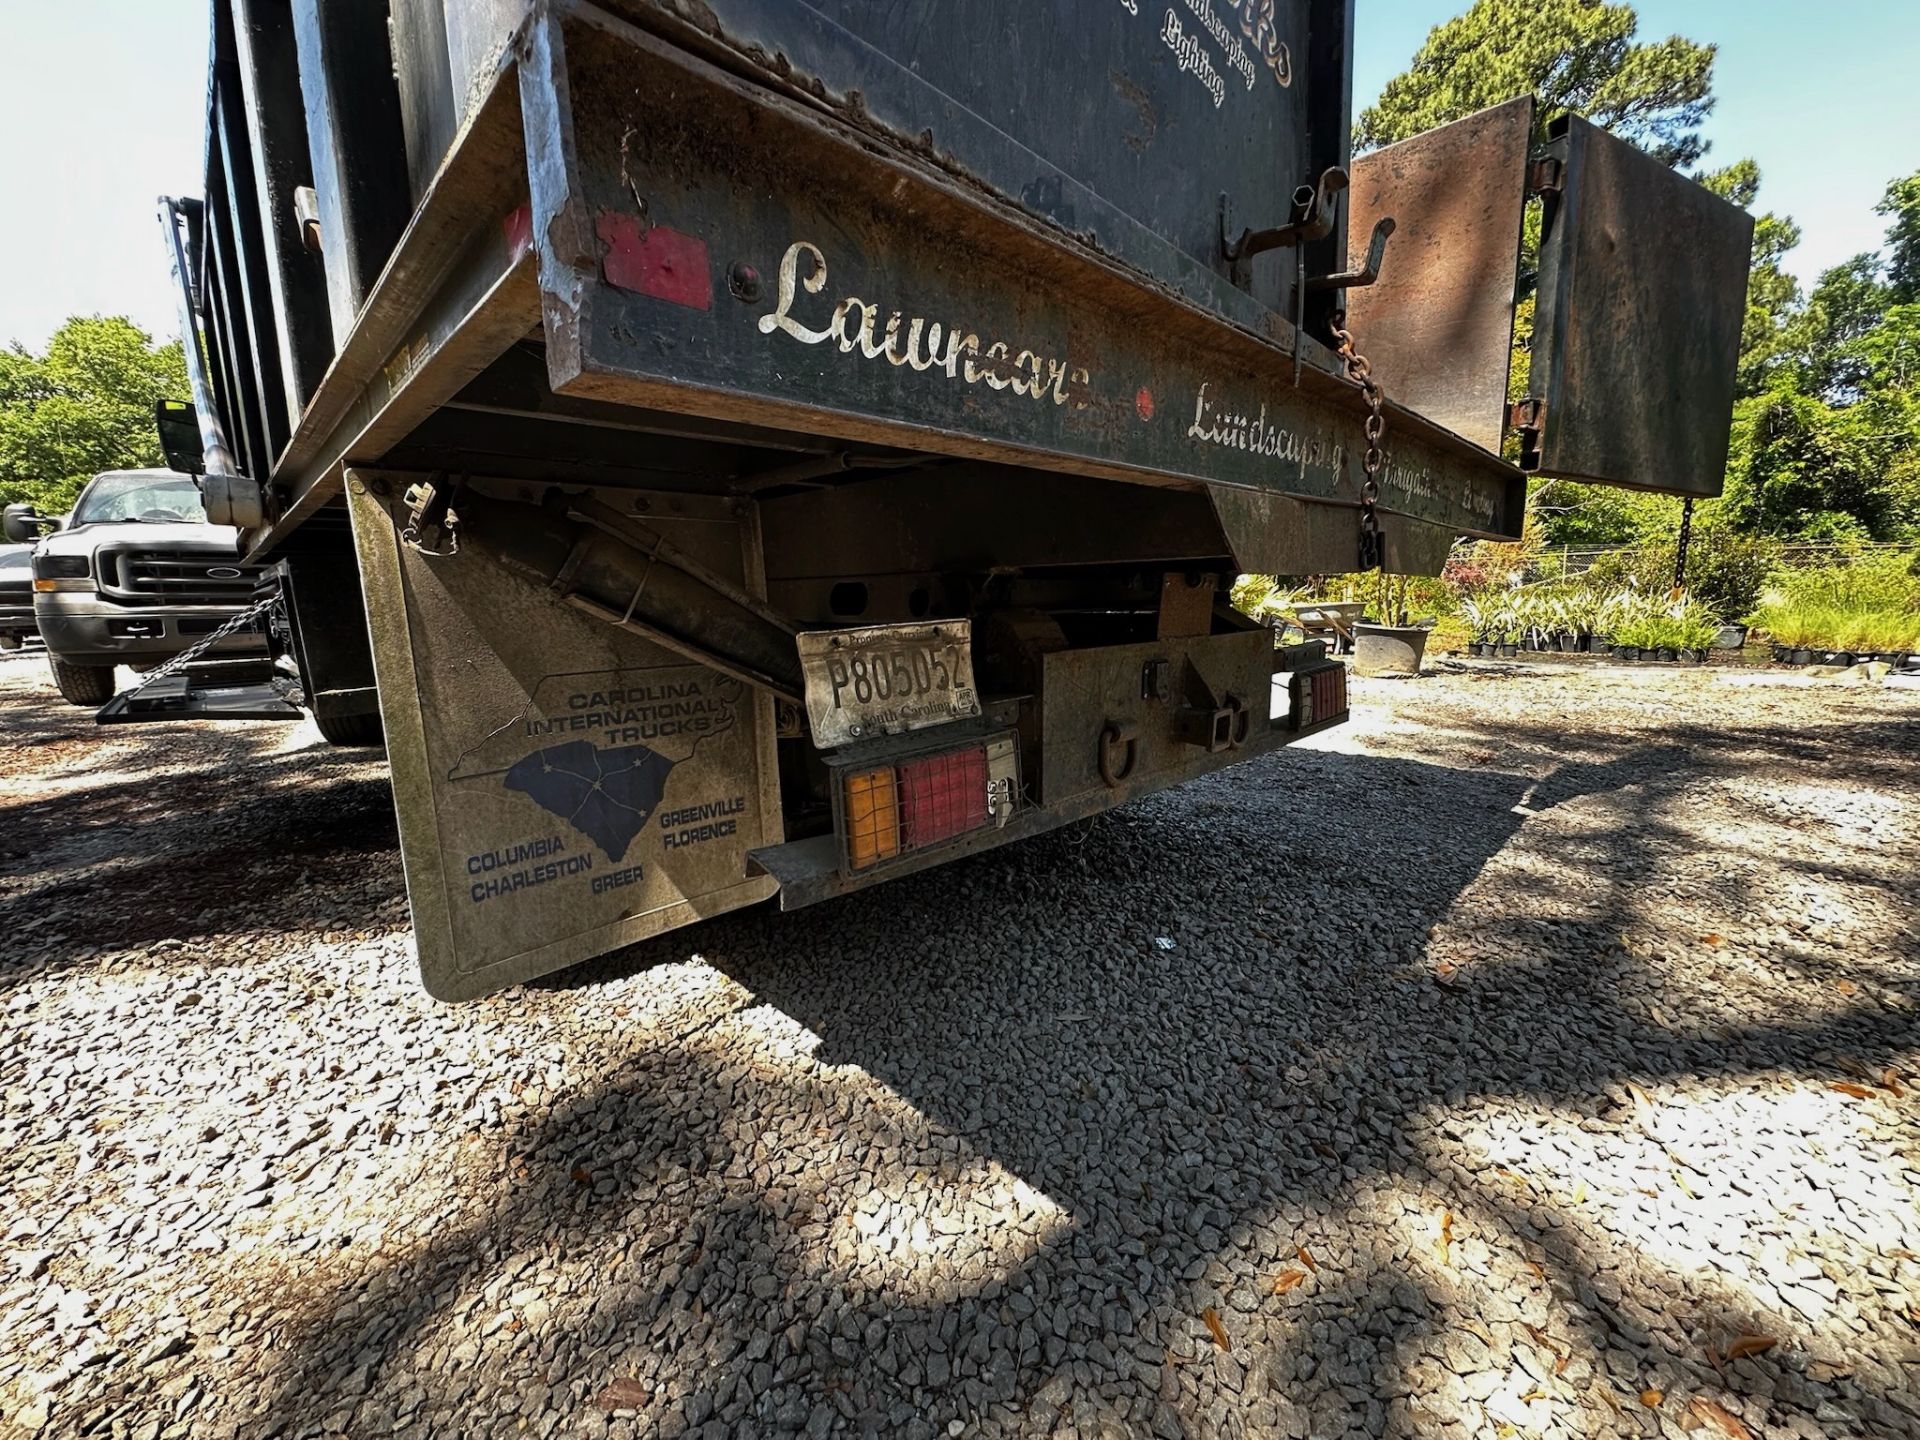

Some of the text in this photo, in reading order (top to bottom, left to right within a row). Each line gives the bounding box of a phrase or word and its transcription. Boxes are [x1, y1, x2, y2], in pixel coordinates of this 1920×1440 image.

[1160, 8, 1225, 108] Lighting
[825, 646, 965, 708] P805052
[568, 682, 702, 710] CAROLINA
[526, 701, 718, 737] INTERNATIONAL
[861, 701, 951, 728] South Carolina
[605, 717, 711, 745] TRUCKS
[660, 797, 746, 829] GREENVILLE
[663, 819, 737, 850] FLORENCE
[467, 836, 565, 875] COLUMBIA
[470, 853, 593, 902] CHARLESTON
[591, 866, 644, 895] GREER
